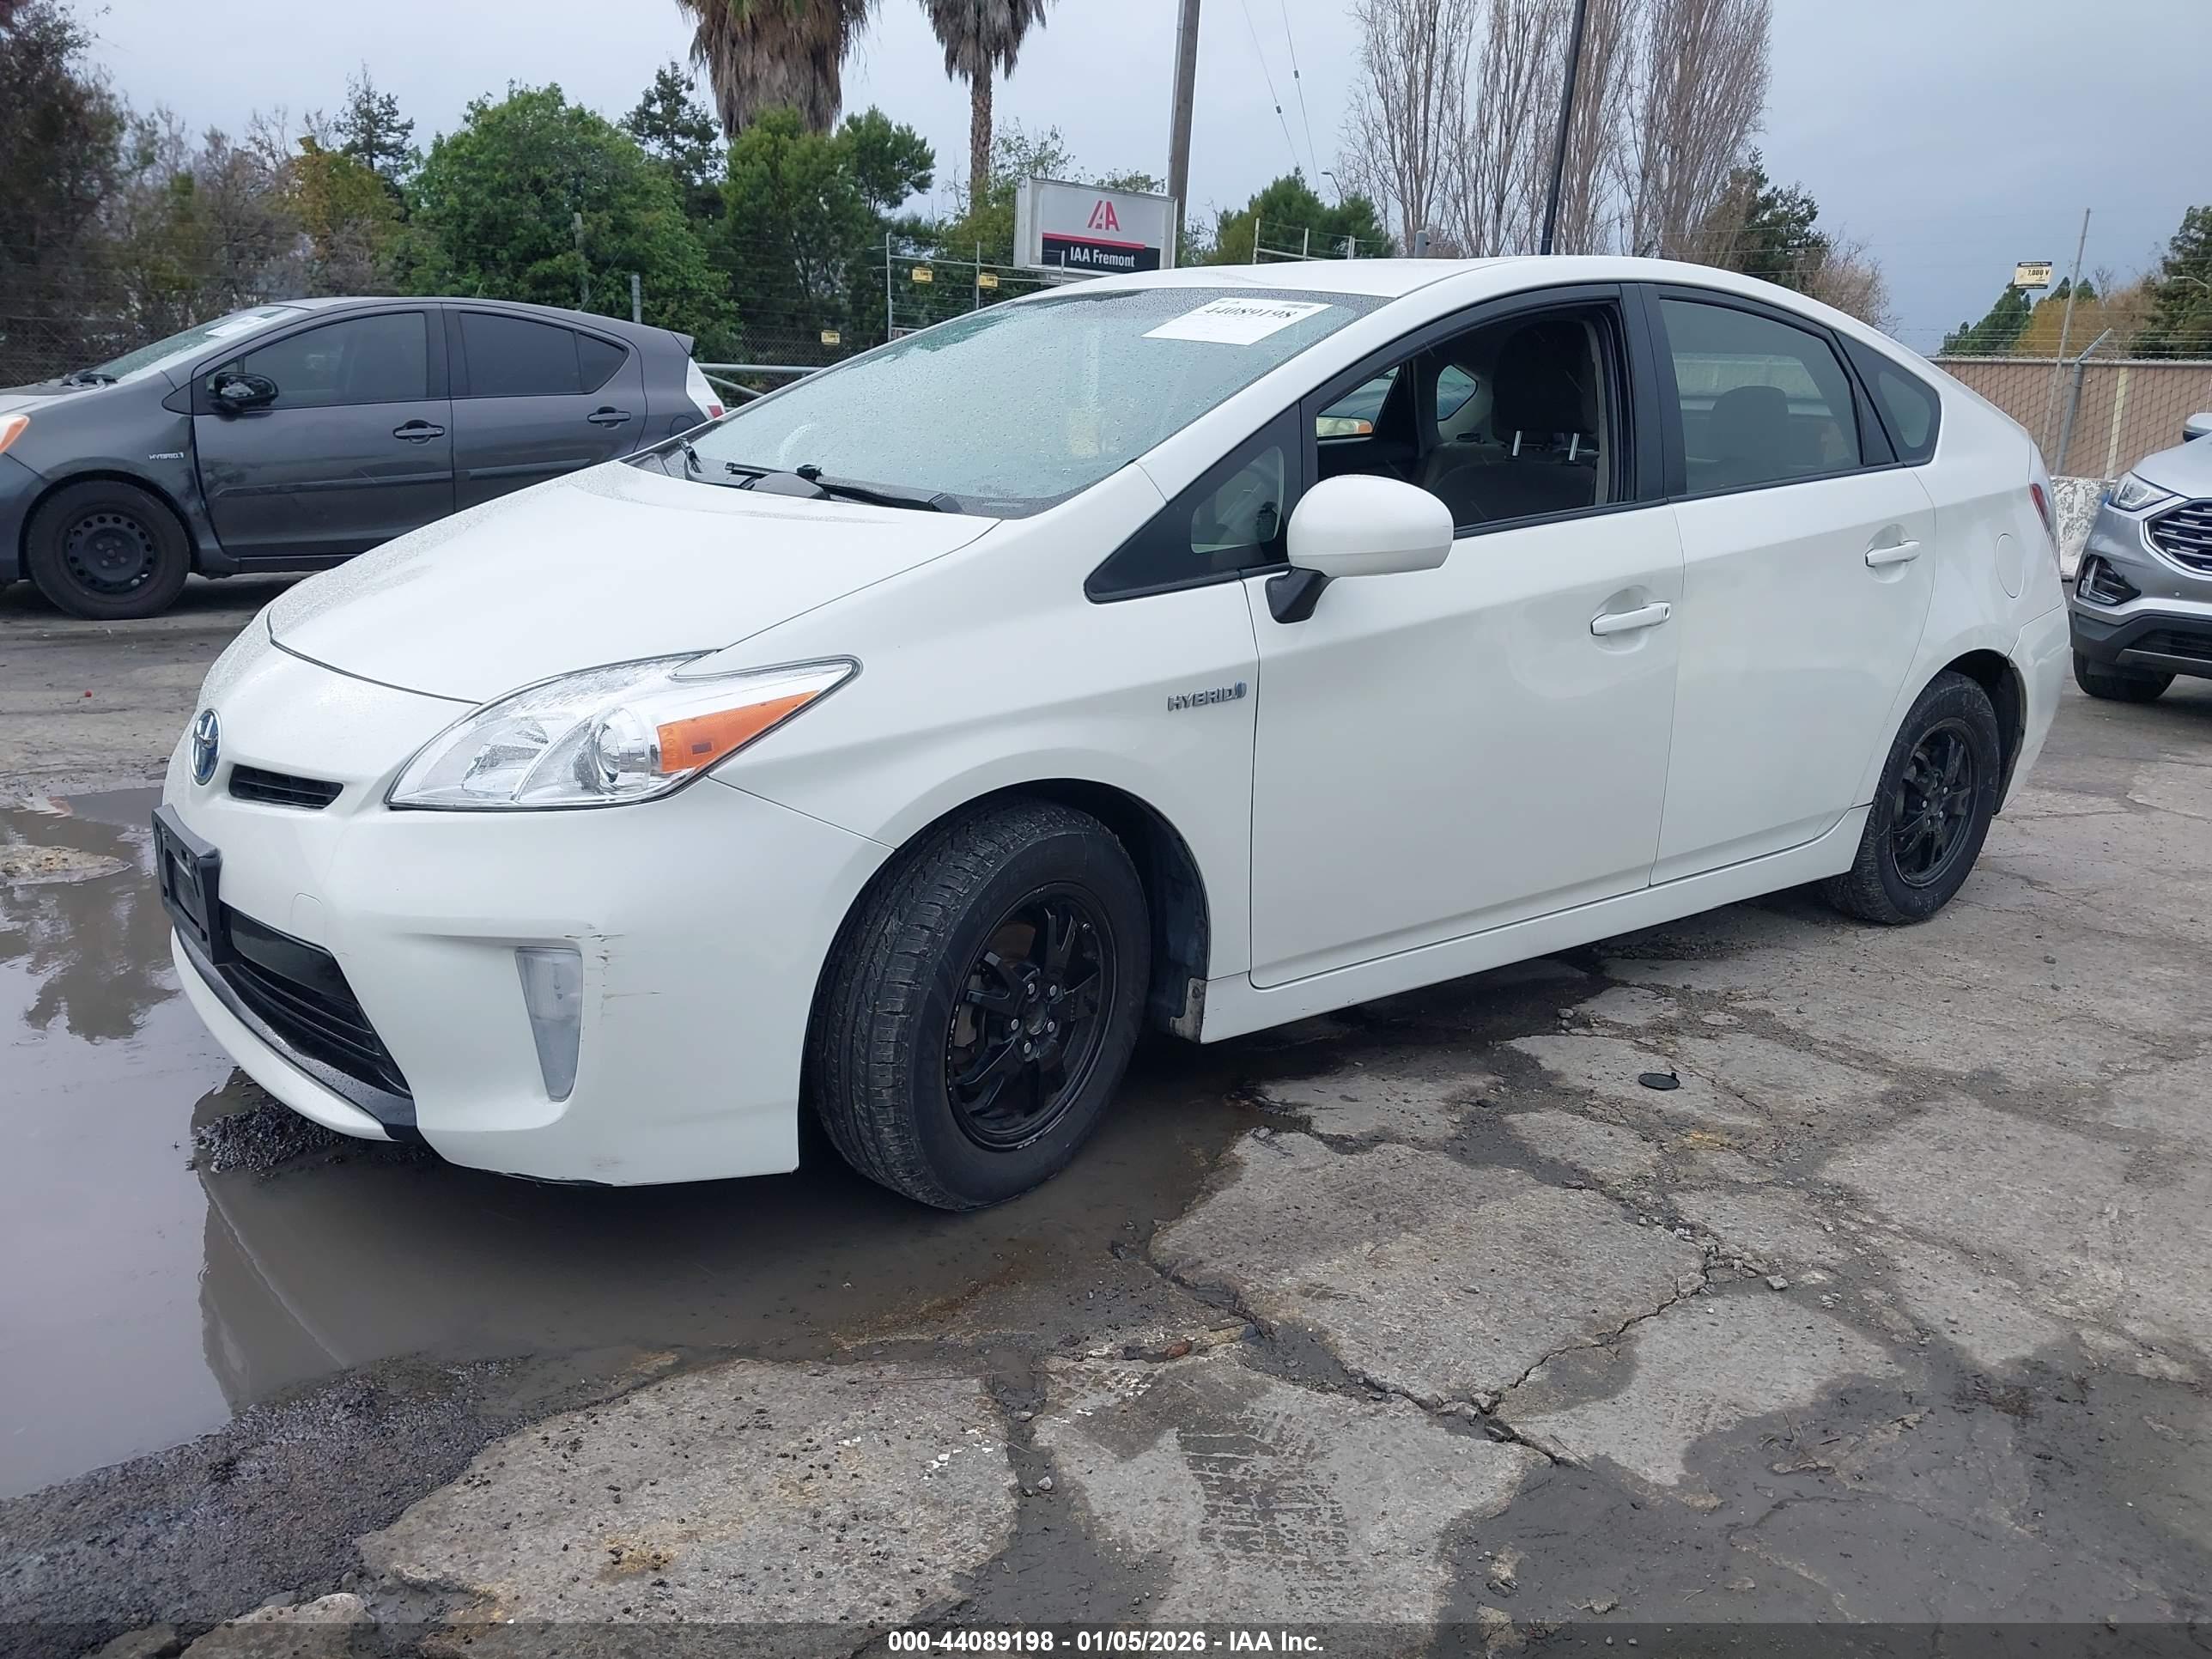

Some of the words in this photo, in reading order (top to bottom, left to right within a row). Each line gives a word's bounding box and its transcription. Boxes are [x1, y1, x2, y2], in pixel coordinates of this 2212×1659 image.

[1070, 246, 1091, 263] IAA
[1092, 249, 1135, 268] Fremont
[1204, 306, 1297, 319] 44089198
[1167, 686, 1237, 712] HYBRID
